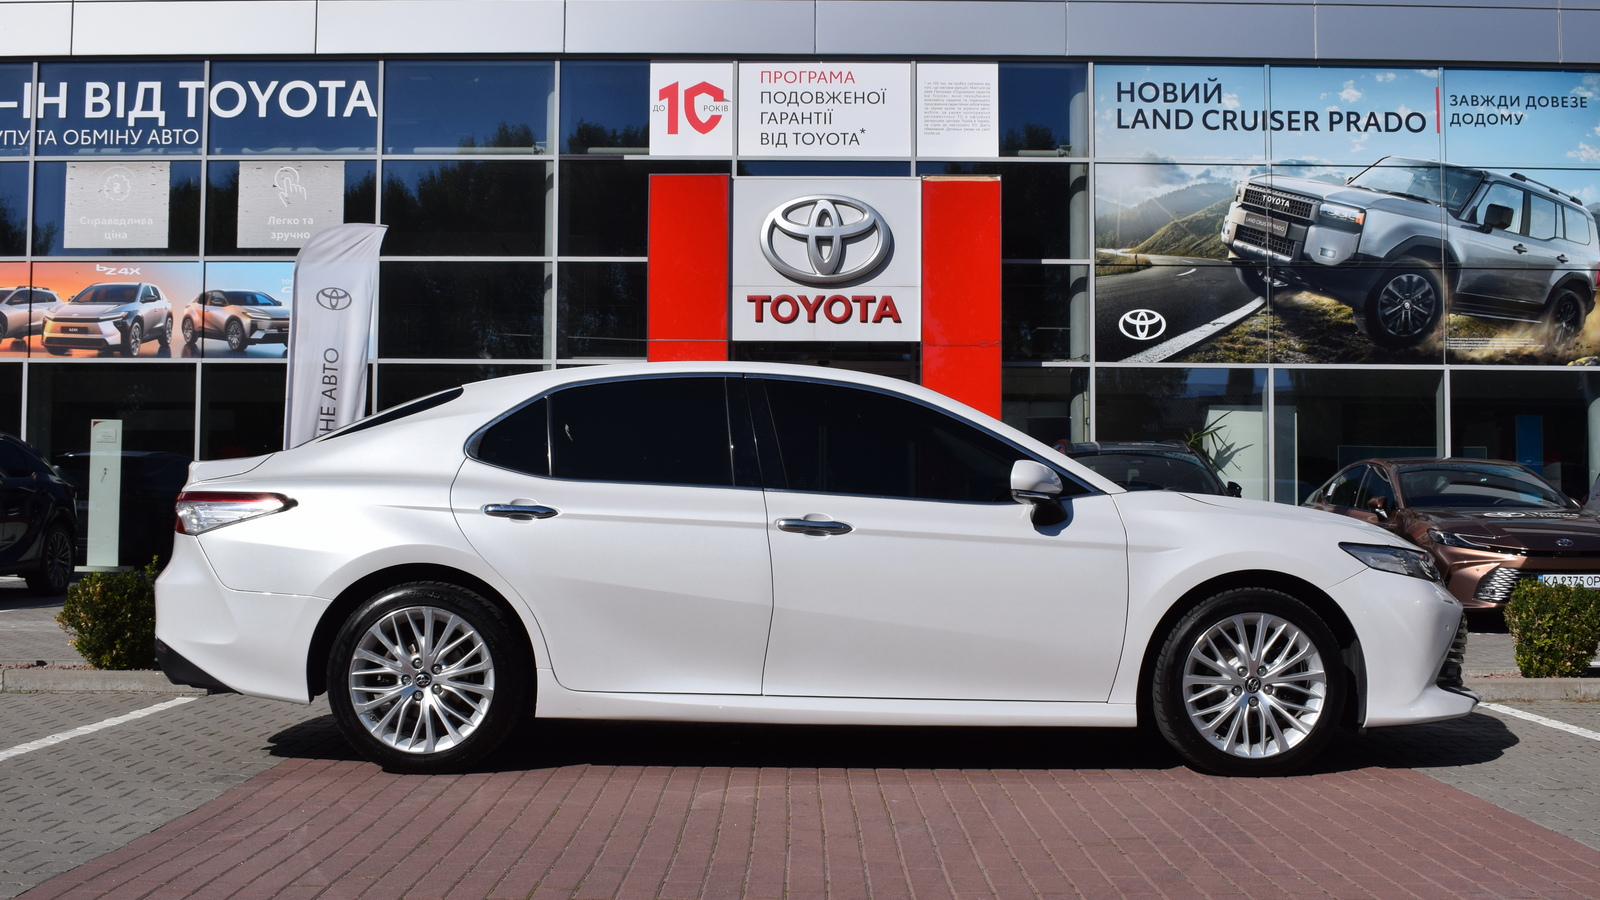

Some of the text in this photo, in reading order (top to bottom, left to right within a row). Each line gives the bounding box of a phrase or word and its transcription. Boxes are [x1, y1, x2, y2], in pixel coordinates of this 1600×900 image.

[760, 71, 855, 83] ПРОГРАМА
[760, 88, 887, 107] ПОДОВЖЕНОЇ
[1117, 78, 1222, 104] НОВИЙ
[85, 81, 166, 127] ВІД
[179, 80, 378, 119] TOYOTA
[1450, 94, 1588, 110] ЗАВЖДИ ДОВЕЗЕ
[760, 109, 833, 125] ГАРАНТІЇ
[1117, 108, 1426, 133] LAND CRUISER PRADO
[1450, 113, 1524, 127] ДОДОМУ
[37, 130, 57, 145] ТА
[63, 129, 142, 146] ОБМІНУ
[147, 129, 199, 145] АВТО
[760, 132, 788, 148] ВІД
[1262, 195, 1290, 207] TOYOTA
[80, 216, 153, 227] Справедлива
[267, 216, 314, 225] Легко та
[104, 230, 128, 240] ціна
[270, 231, 311, 241] зручно
[747, 294, 902, 324] TOYOTA
[321, 348, 339, 401] АВТО
